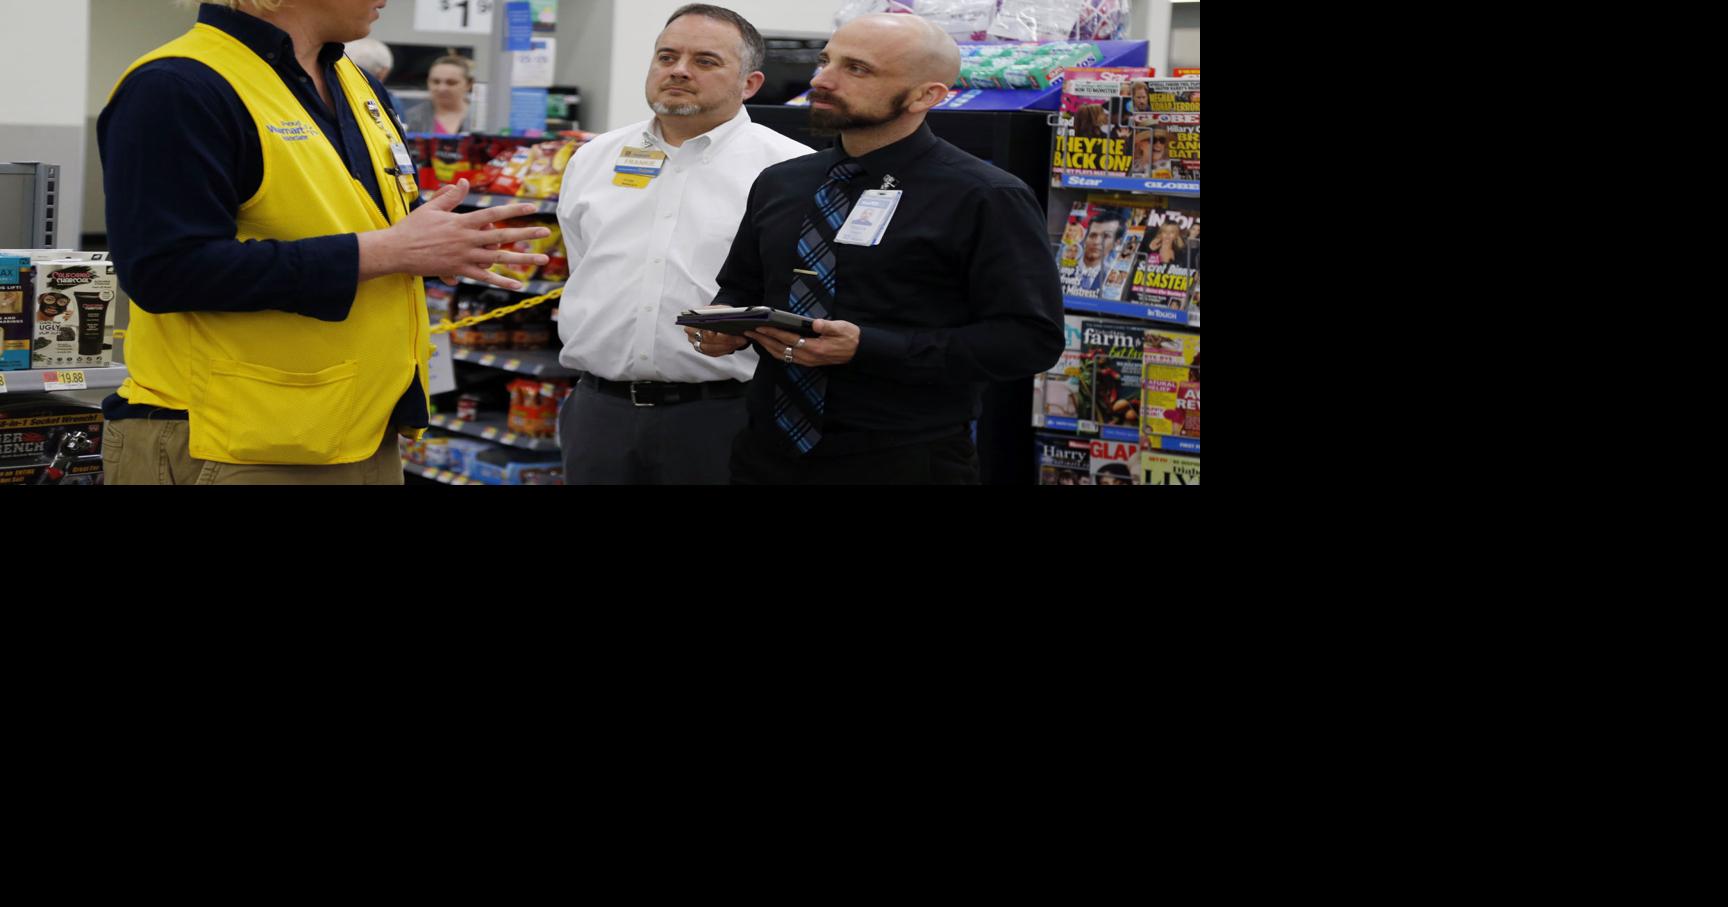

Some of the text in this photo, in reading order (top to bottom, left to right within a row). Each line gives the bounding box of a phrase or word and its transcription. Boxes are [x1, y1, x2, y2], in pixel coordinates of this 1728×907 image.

[266, 124, 304, 135] Walmart
[1166, 125, 1195, 134] Hillary
[1056, 136, 1125, 156] THEY'RE
[1053, 150, 1097, 170] BACK
[1099, 155, 1132, 172] ON!
[1067, 176, 1200, 190] Star GLOBE
[1137, 261, 1167, 273] Scret
[1133, 271, 1194, 292] DISASTER!
[1066, 287, 1100, 298] Mistress!
[1083, 328, 1134, 347] farm
[31, 417, 60, 425] Socket
[1043, 445, 1086, 463] Harry
